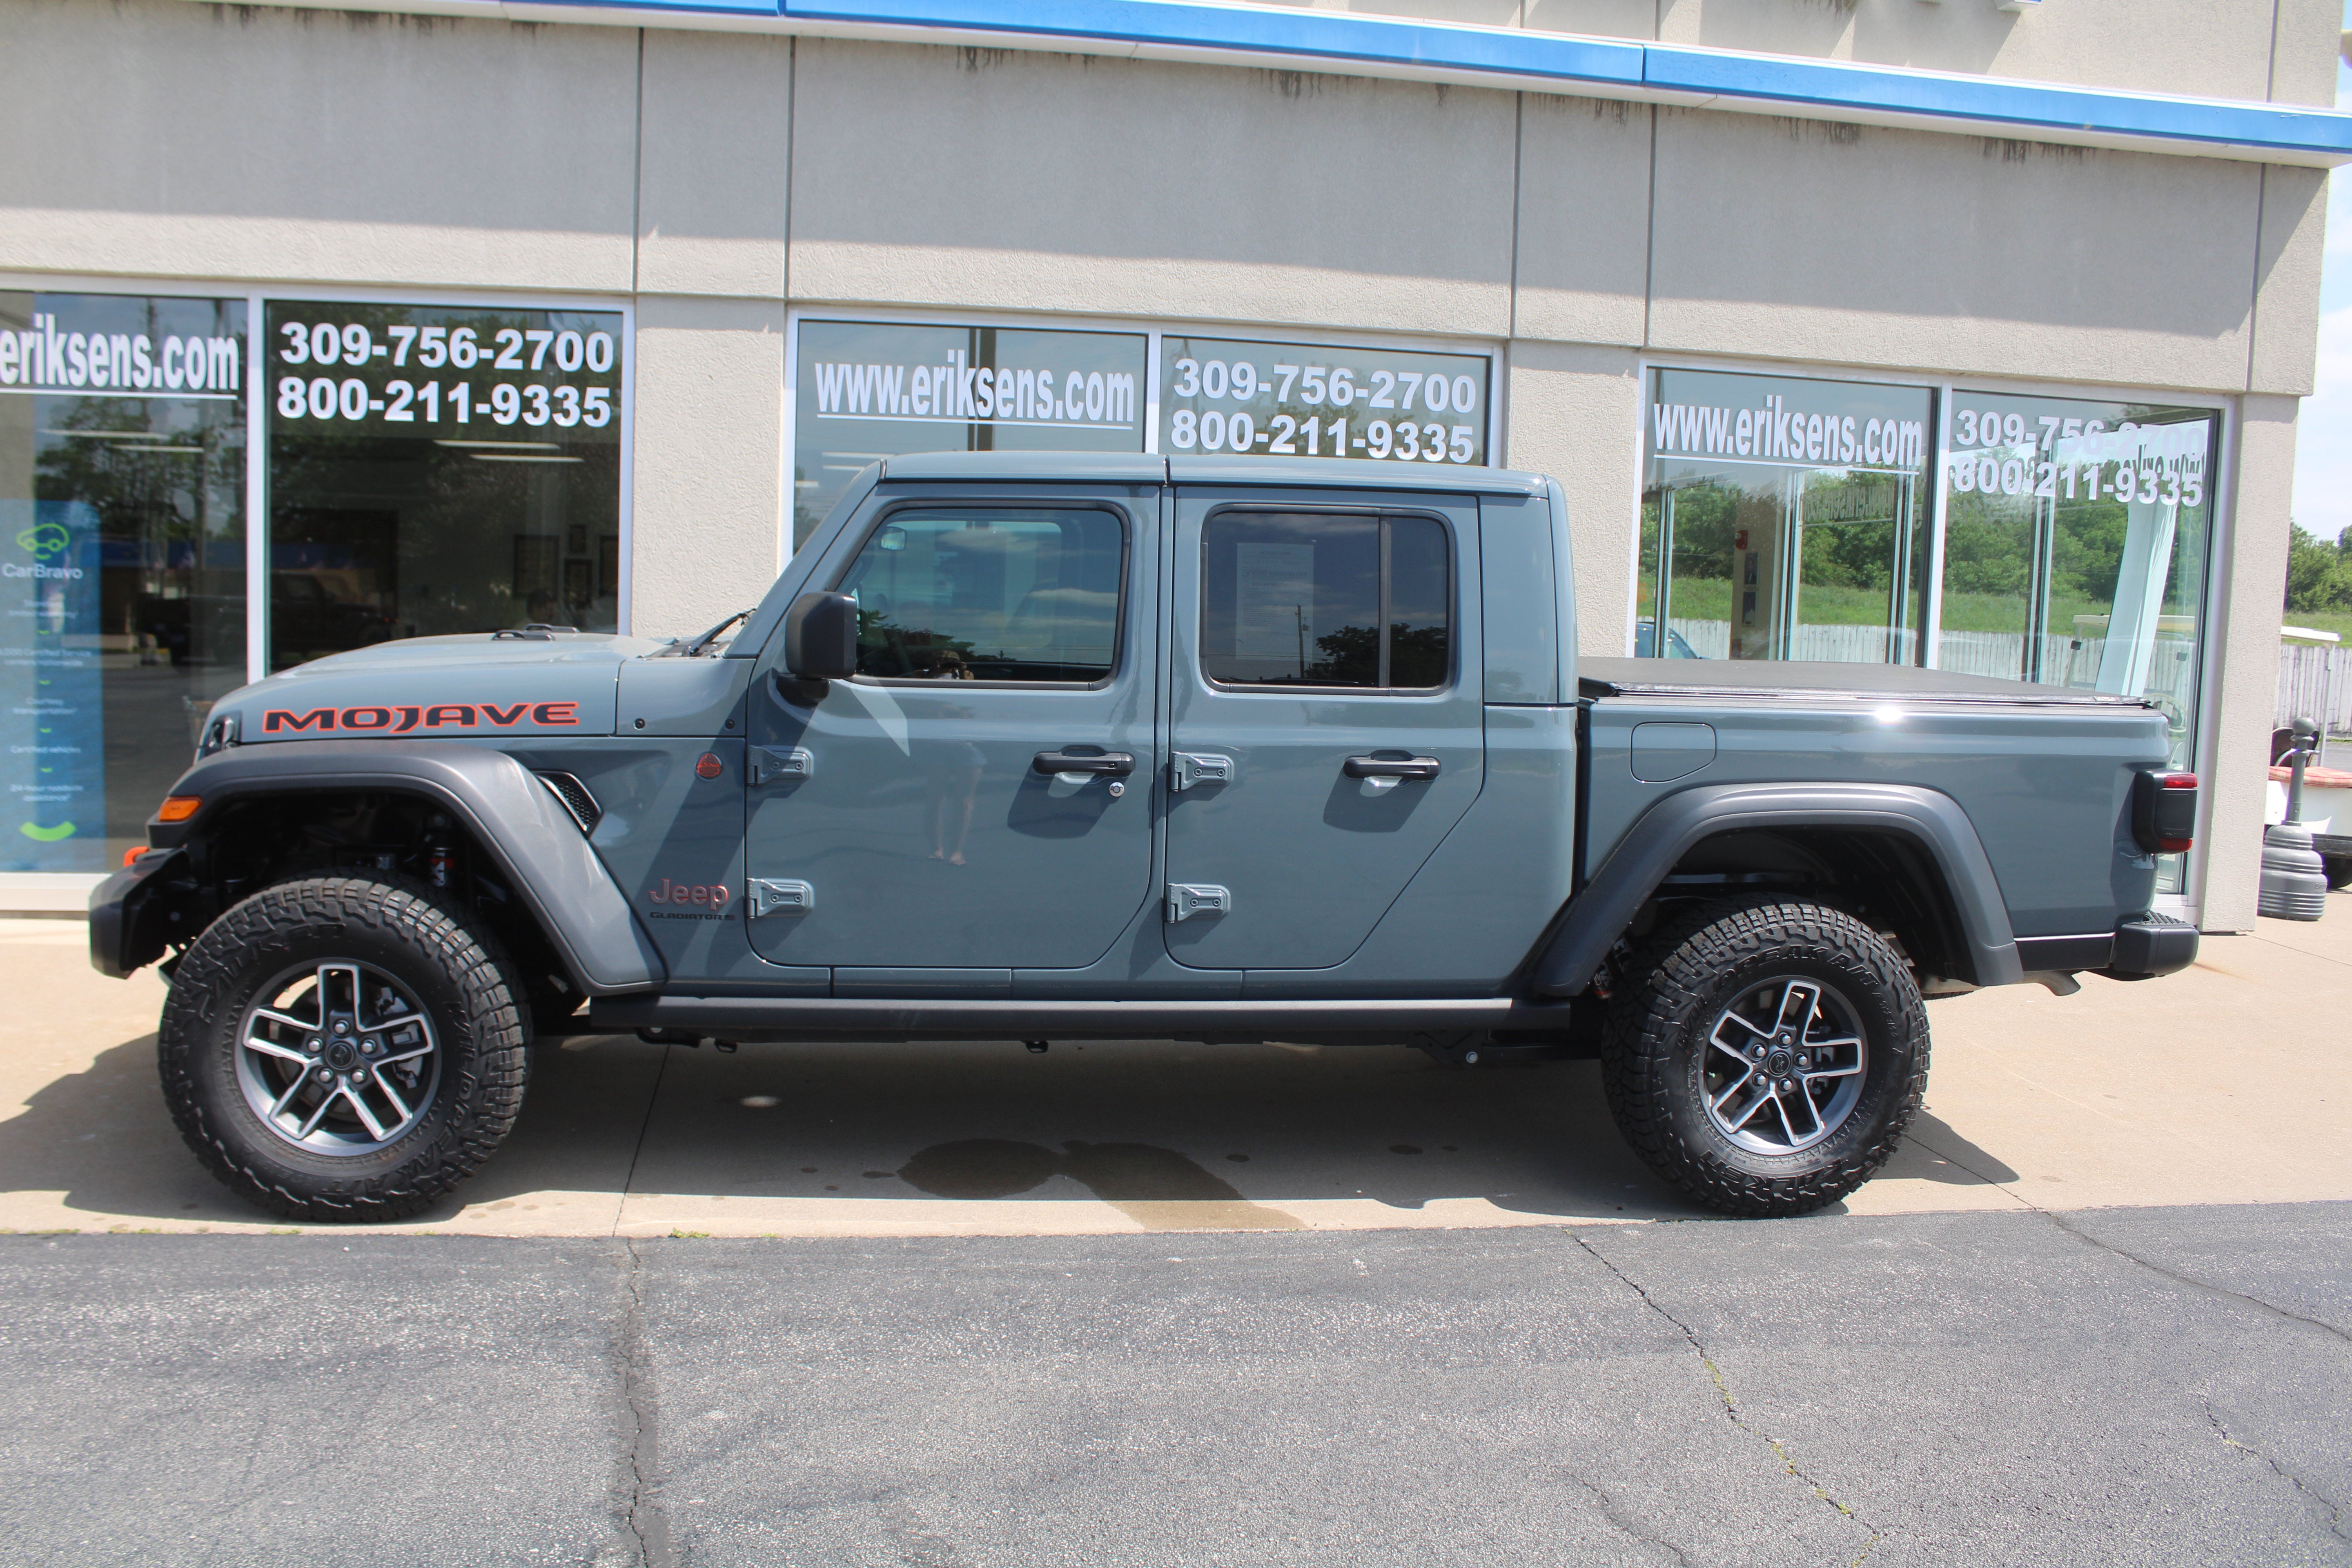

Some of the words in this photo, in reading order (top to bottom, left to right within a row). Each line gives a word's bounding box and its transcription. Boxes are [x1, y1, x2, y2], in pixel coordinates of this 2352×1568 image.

[0, 313, 239, 390] eriksens.com
[279, 322, 614, 373] 309-756-2700
[277, 376, 611, 428] 800-211-9335
[815, 349, 1134, 423] www.eriksens.com
[1173, 358, 1476, 413] 309-756-2700
[1170, 410, 1474, 463] 800-211-9335
[1654, 394, 1922, 466] www.eriksens.com
[1956, 409, 2205, 462] 309-756-2700
[1953, 456, 2203, 508] 800-211-9335
[2, 562, 84, 579] CarBravo
[262, 702, 580, 734] MOJAVE
[648, 878, 729, 911] Jeep
[650, 911, 722, 920] GLADIATOR
